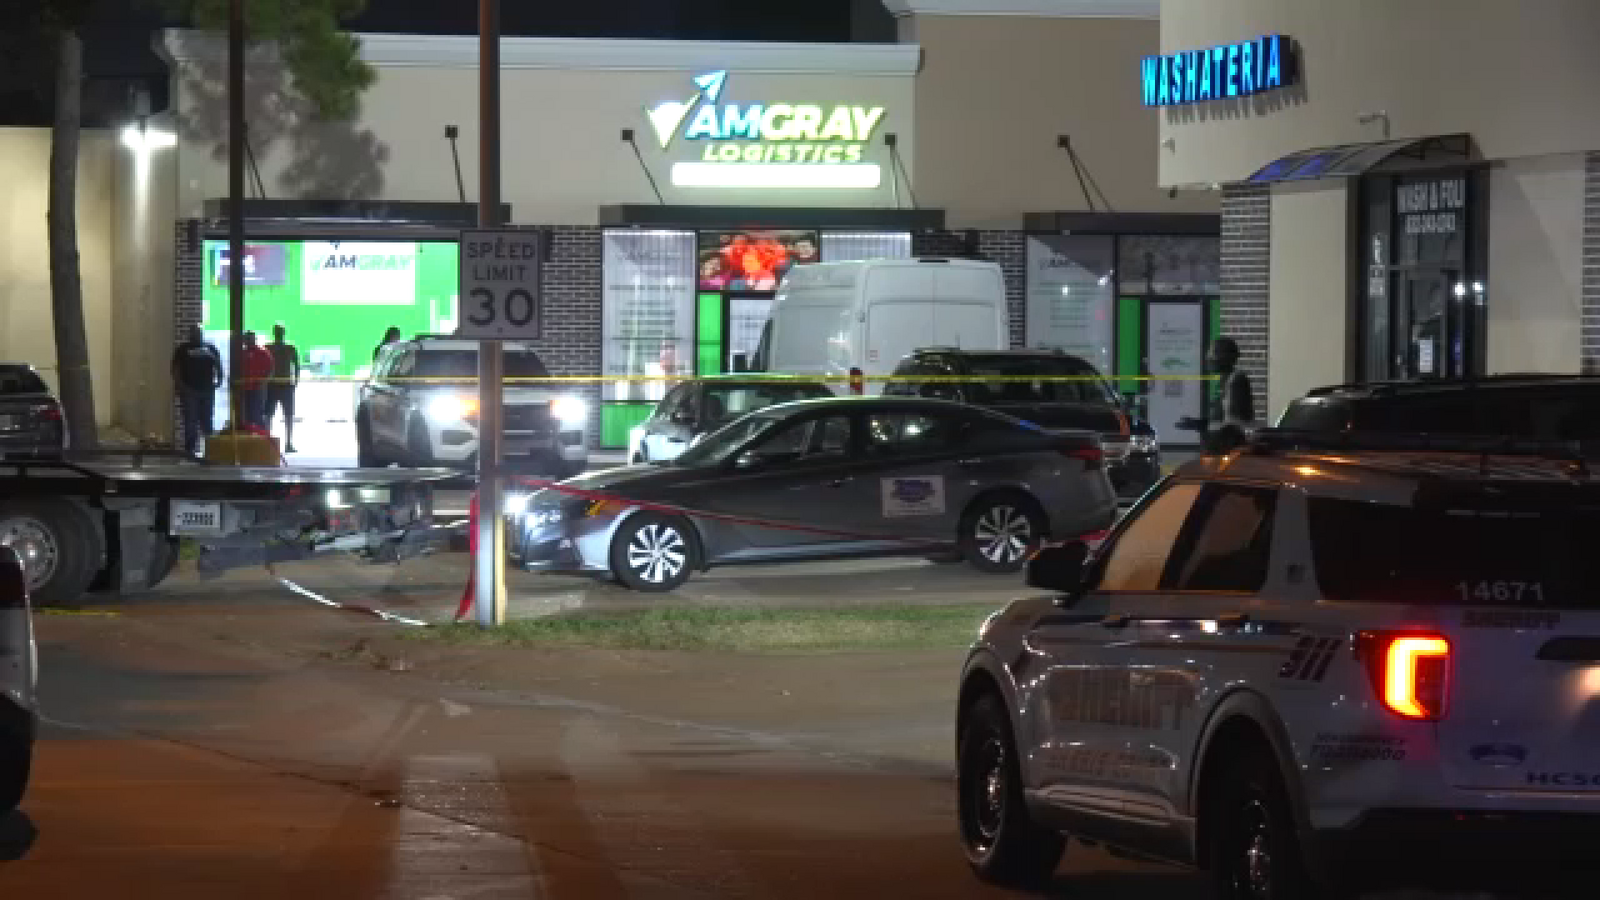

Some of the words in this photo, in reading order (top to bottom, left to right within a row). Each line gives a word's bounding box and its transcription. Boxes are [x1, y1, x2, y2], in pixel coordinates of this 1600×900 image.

[1140, 36, 1281, 106] WASHATERIA
[685, 103, 884, 141] AMGRAY
[702, 143, 861, 162] LOGISTICS
[467, 241, 535, 259] SPEED
[473, 265, 527, 281] LIMIT
[467, 287, 534, 327] 30
[1455, 580, 1544, 601] 14671
[1279, 637, 1343, 681] 911
